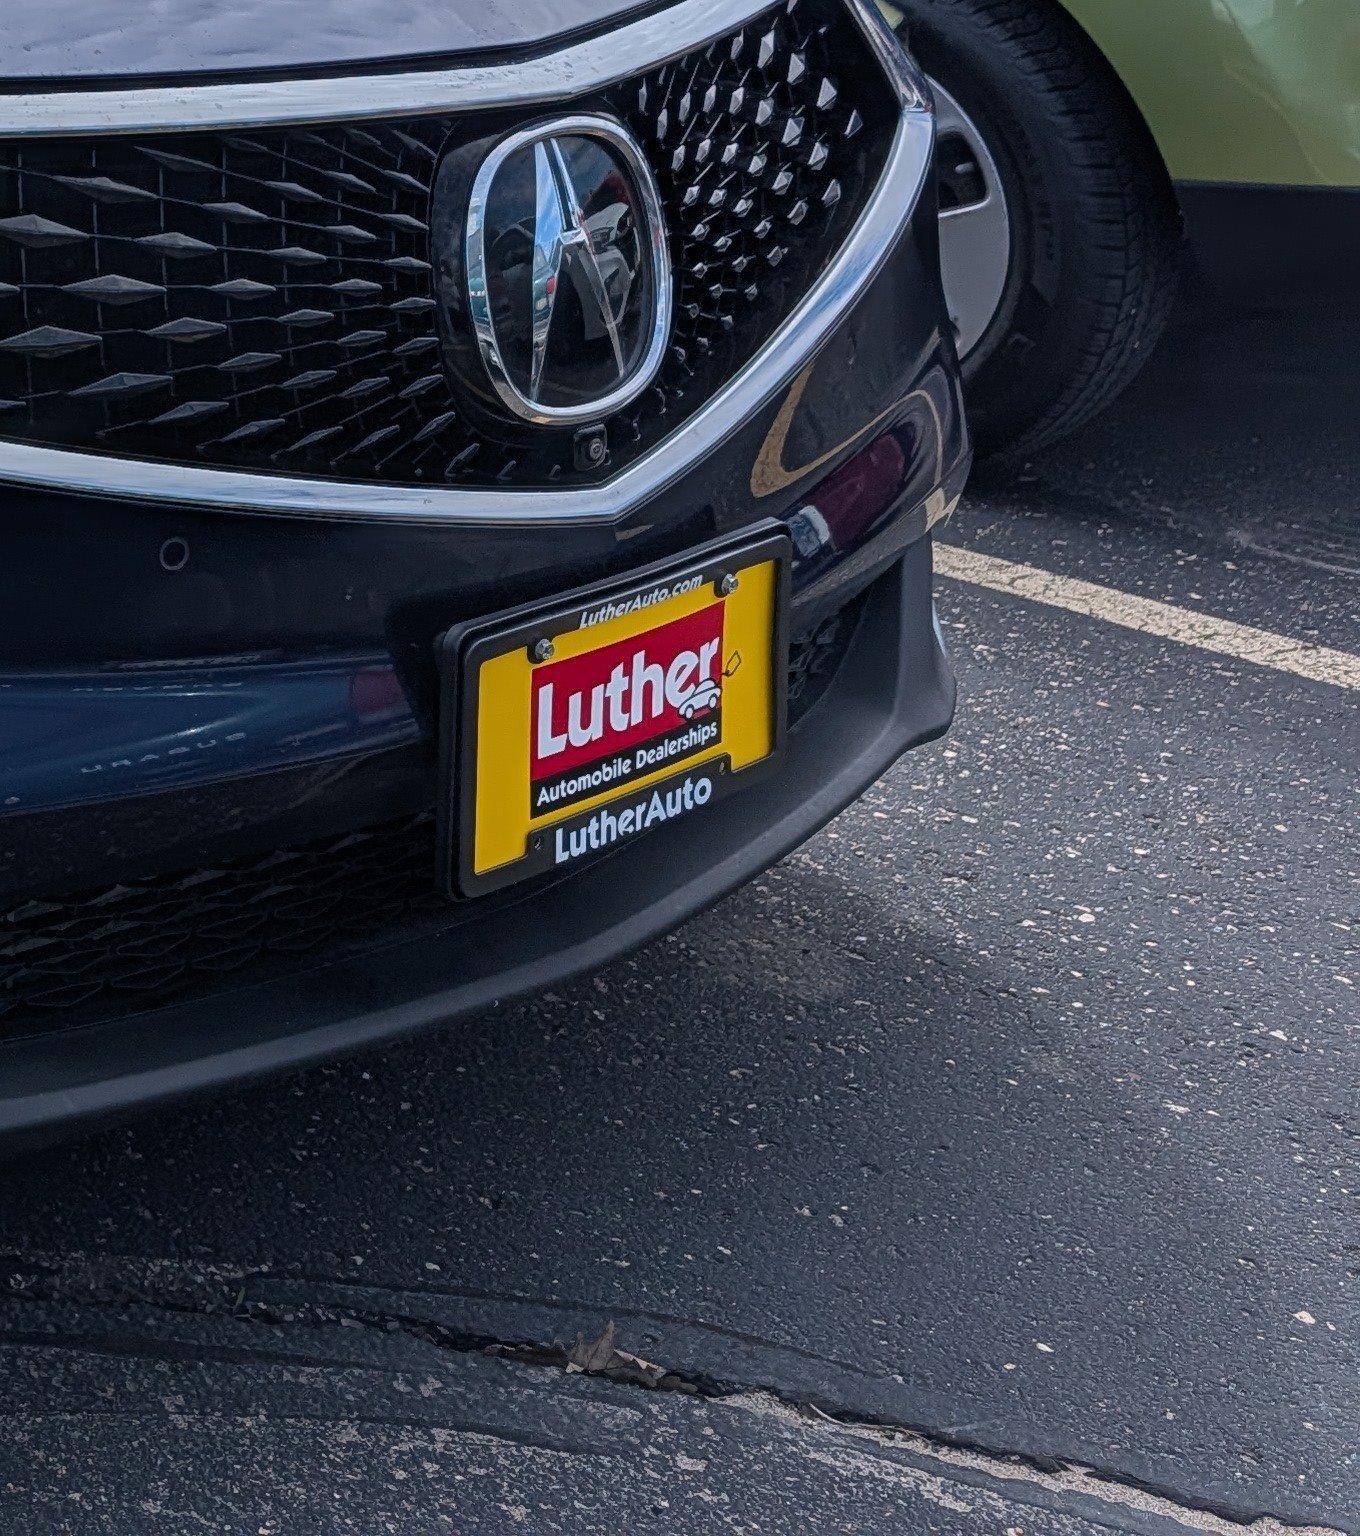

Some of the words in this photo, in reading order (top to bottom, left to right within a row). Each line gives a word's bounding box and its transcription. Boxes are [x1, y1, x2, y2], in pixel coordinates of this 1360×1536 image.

[580, 574, 703, 629] LutherAuto.com
[537, 636, 721, 760] Luther
[536, 757, 632, 807] Automobile
[635, 721, 718, 770] Dealerships
[555, 776, 712, 864] LutherAuto
